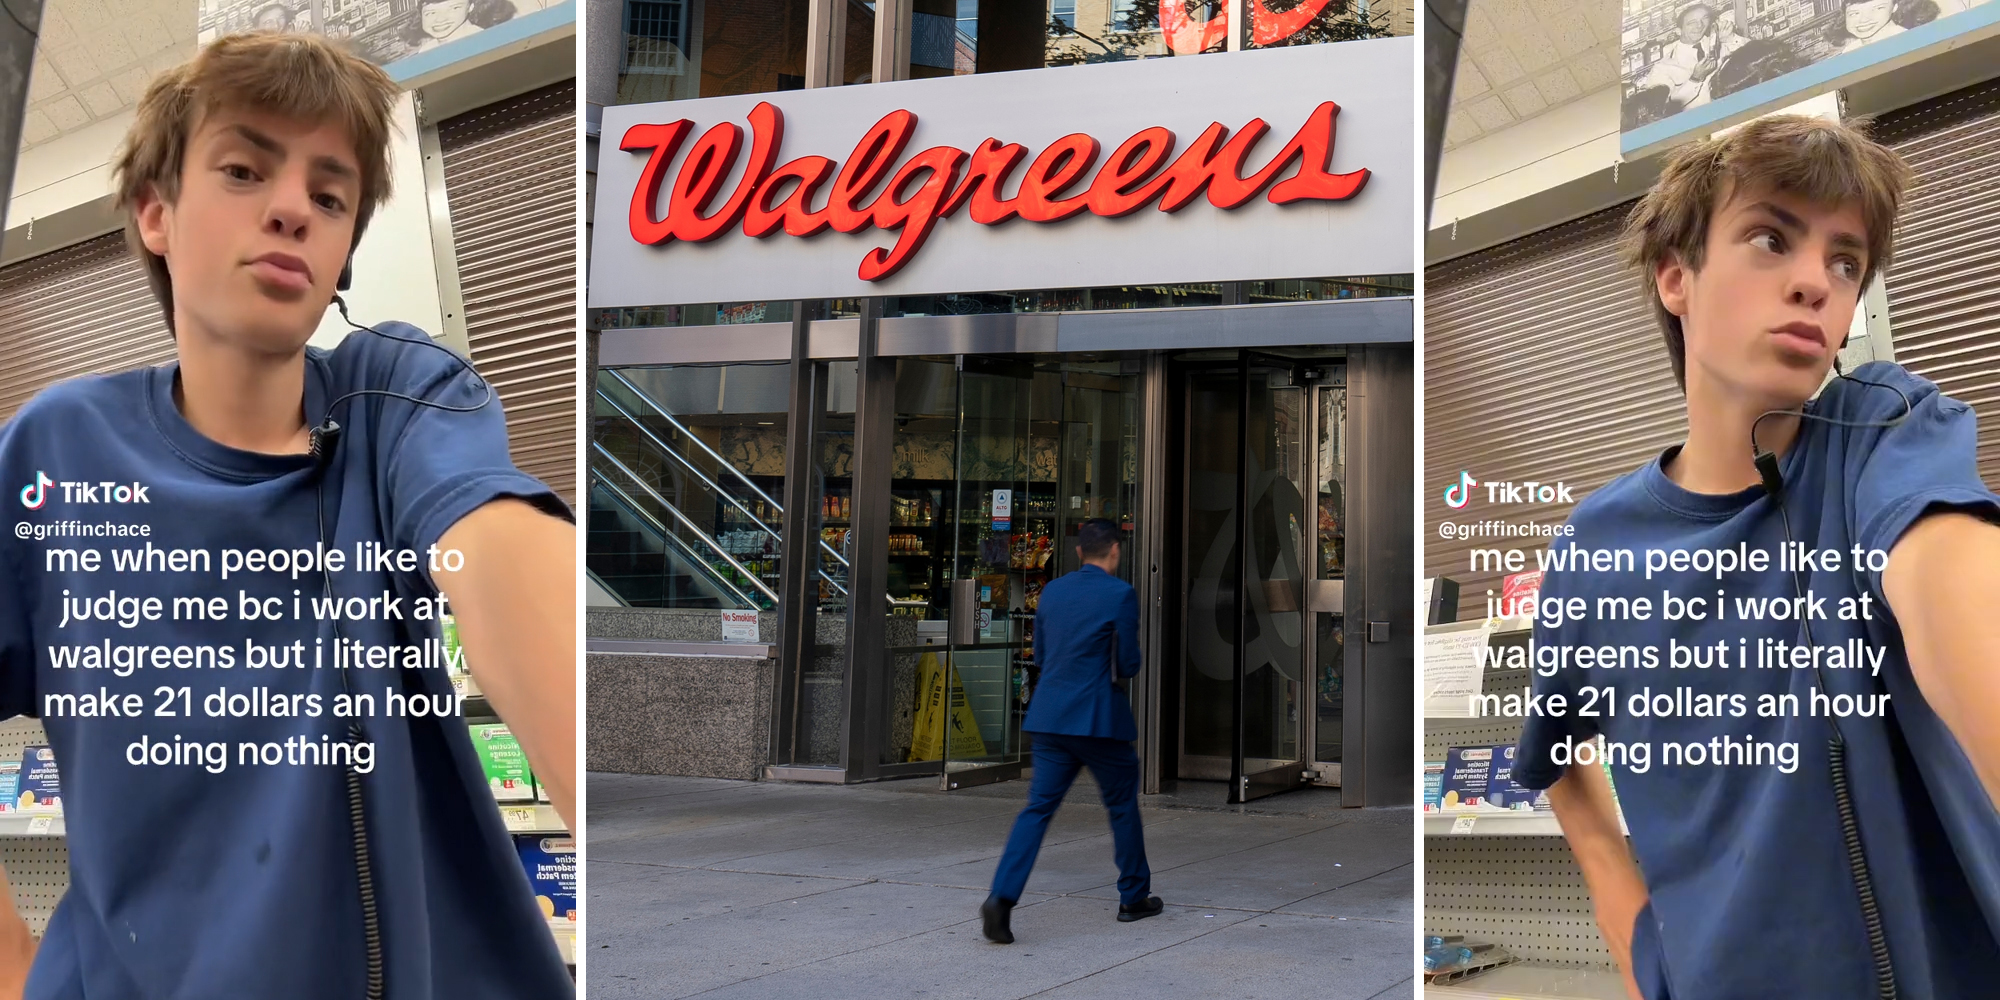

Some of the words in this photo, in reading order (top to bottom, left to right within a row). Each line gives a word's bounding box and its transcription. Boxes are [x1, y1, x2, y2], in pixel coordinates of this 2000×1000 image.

[619, 101, 1372, 282] Walgreens
[902, 449, 930, 463] milk
[722, 612, 731, 622] No
[731, 612, 757, 625] Smoking
